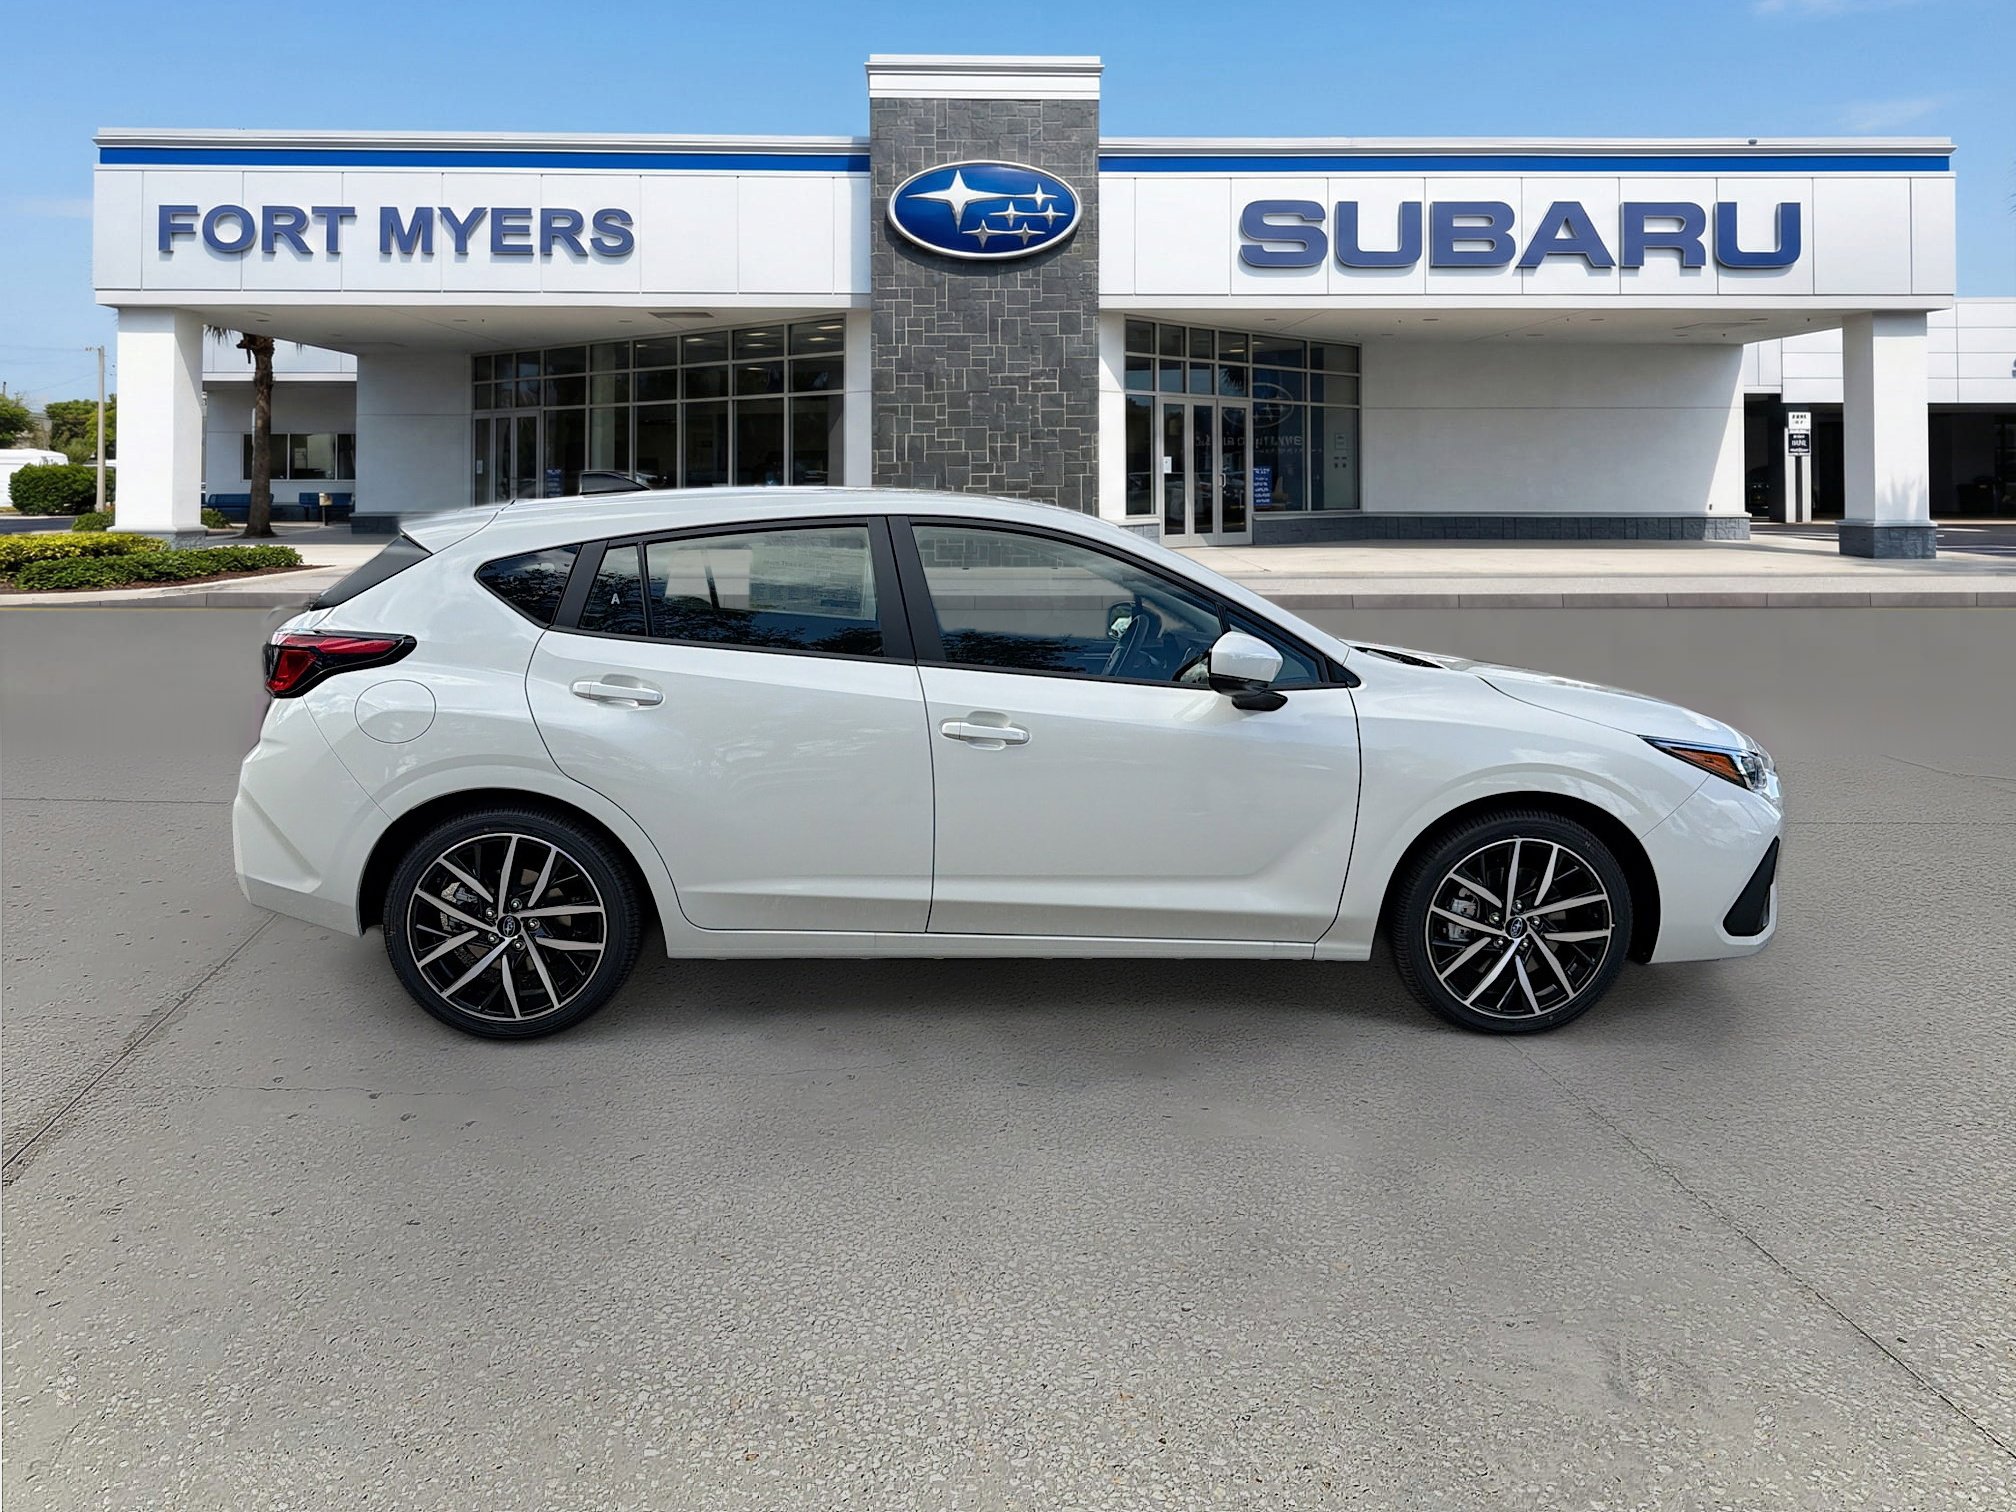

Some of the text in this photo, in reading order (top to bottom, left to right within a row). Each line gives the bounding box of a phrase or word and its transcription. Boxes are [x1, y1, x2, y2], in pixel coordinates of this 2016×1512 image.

[158, 204, 634, 258] FORT MYERS
[1238, 199, 1803, 271] SUBARU
[611, 593, 620, 605] A
